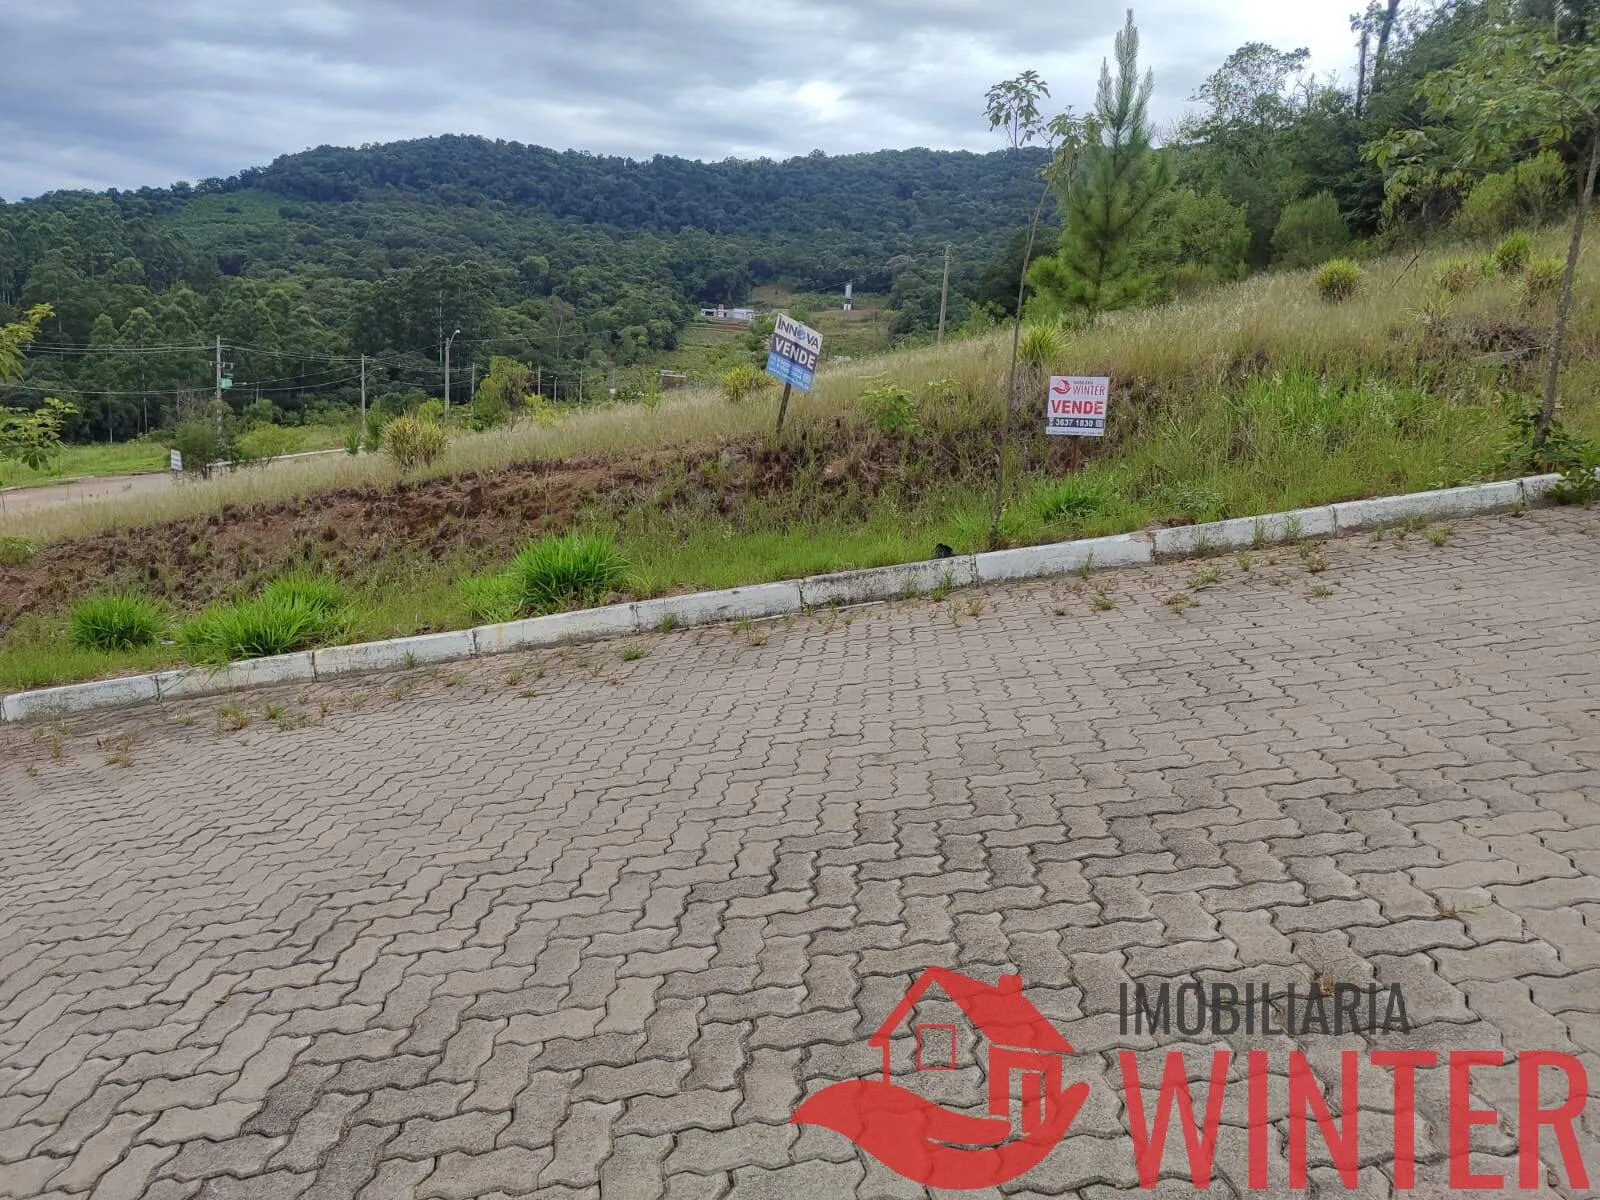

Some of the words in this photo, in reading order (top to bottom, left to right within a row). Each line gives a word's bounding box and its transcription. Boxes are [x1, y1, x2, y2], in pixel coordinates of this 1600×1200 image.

[778, 315, 819, 349] INNOVA
[775, 337, 816, 370] VENDE
[1073, 385, 1105, 396] WINTER
[1051, 399, 1104, 415] VENDE
